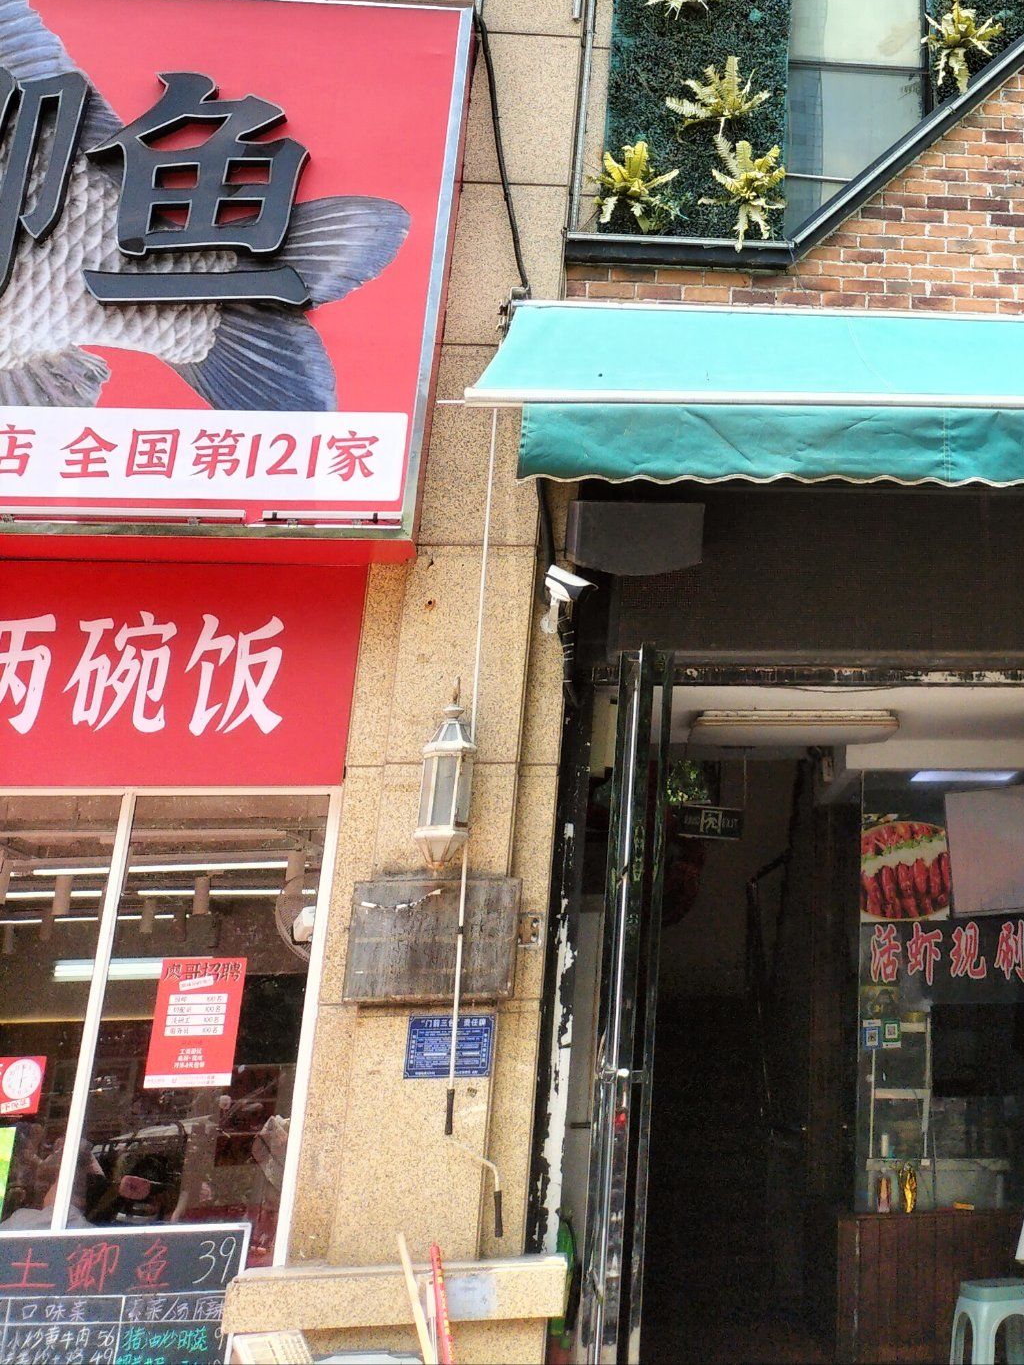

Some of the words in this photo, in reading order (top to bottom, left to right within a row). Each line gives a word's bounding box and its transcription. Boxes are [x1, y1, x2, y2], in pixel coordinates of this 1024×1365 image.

[60, 426, 381, 483] 全国第121家
[0, 610, 285, 736] 两碗饭
[191, 1236, 237, 1285] 39
[21, 1301, 88, 1322] 口味菜
